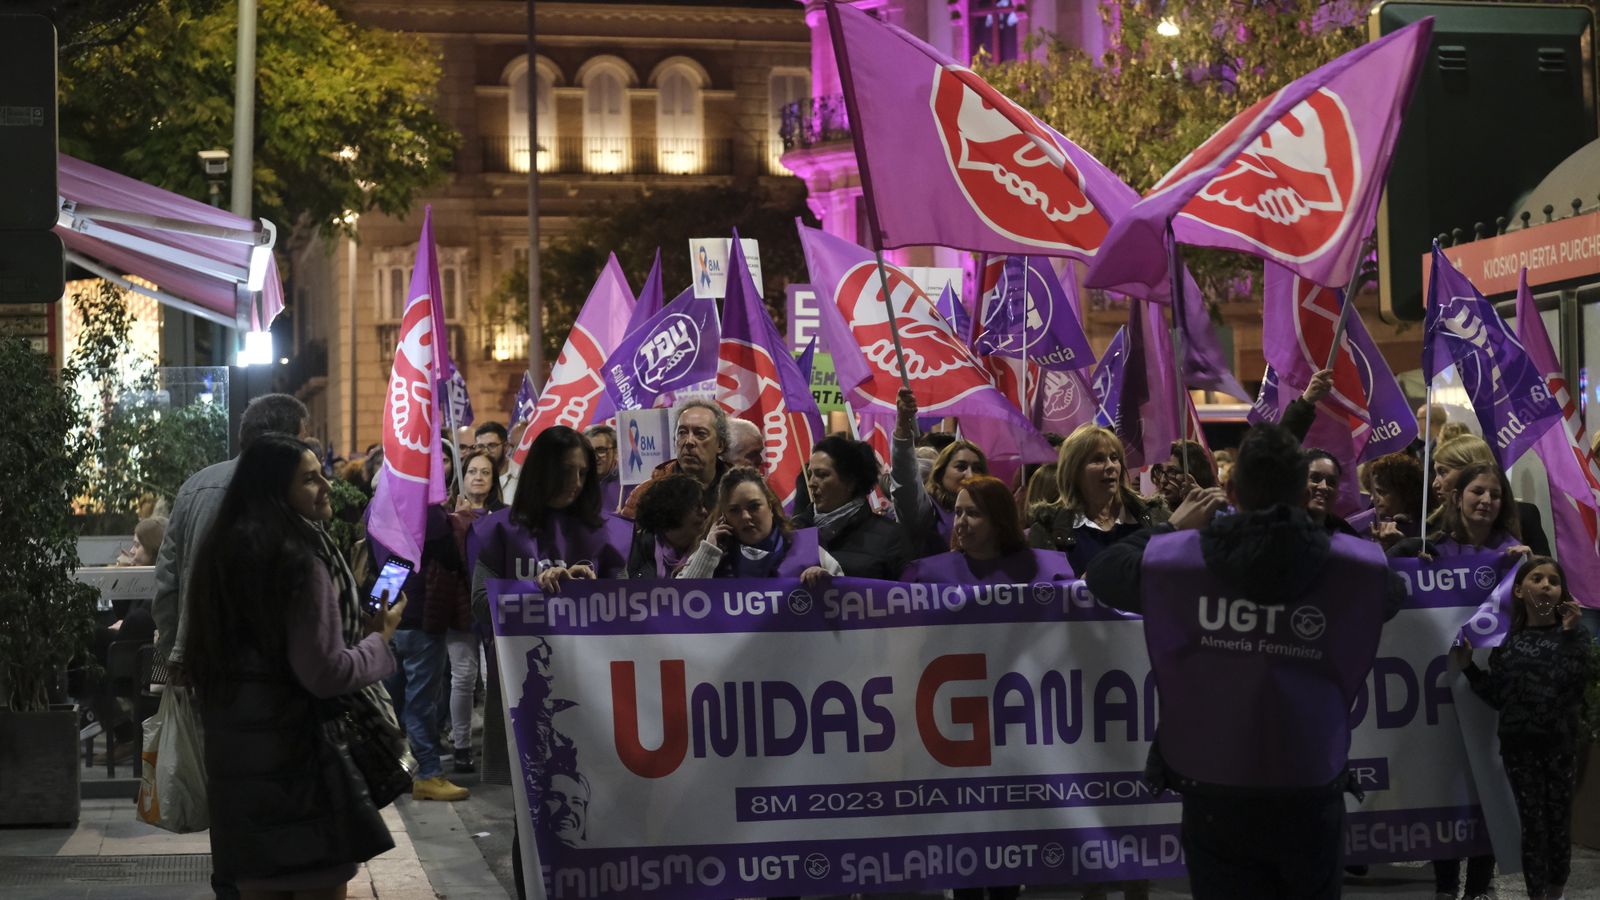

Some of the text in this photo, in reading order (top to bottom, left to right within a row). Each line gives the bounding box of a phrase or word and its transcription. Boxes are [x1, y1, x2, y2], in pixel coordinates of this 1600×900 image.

[707, 259, 721, 272] 8M
[1483, 235, 1600, 280] KIOSKO PUERTA PURCHE
[1033, 345, 1076, 367] lucía
[640, 436, 656, 451] 8M
[1368, 418, 1402, 444] ucía
[1416, 567, 1471, 592] UGT
[497, 587, 712, 627] FEMINISMO
[723, 590, 784, 615] UGT
[823, 584, 966, 620] SALARIO
[973, 584, 1028, 606] UGT
[1197, 596, 1285, 635] UGT
[1200, 635, 1323, 661] Almería Feminista
[610, 658, 896, 779] UNIDAS
[915, 652, 1159, 768] GANA
[750, 779, 1152, 814] 8M 2023 DÍA INTERNACION
[737, 855, 800, 882] UGT
[840, 844, 978, 885] SALARIO
[985, 842, 1039, 869] UGT
[1071, 834, 1186, 877] IGUALD
[1436, 818, 1478, 844] UGT
